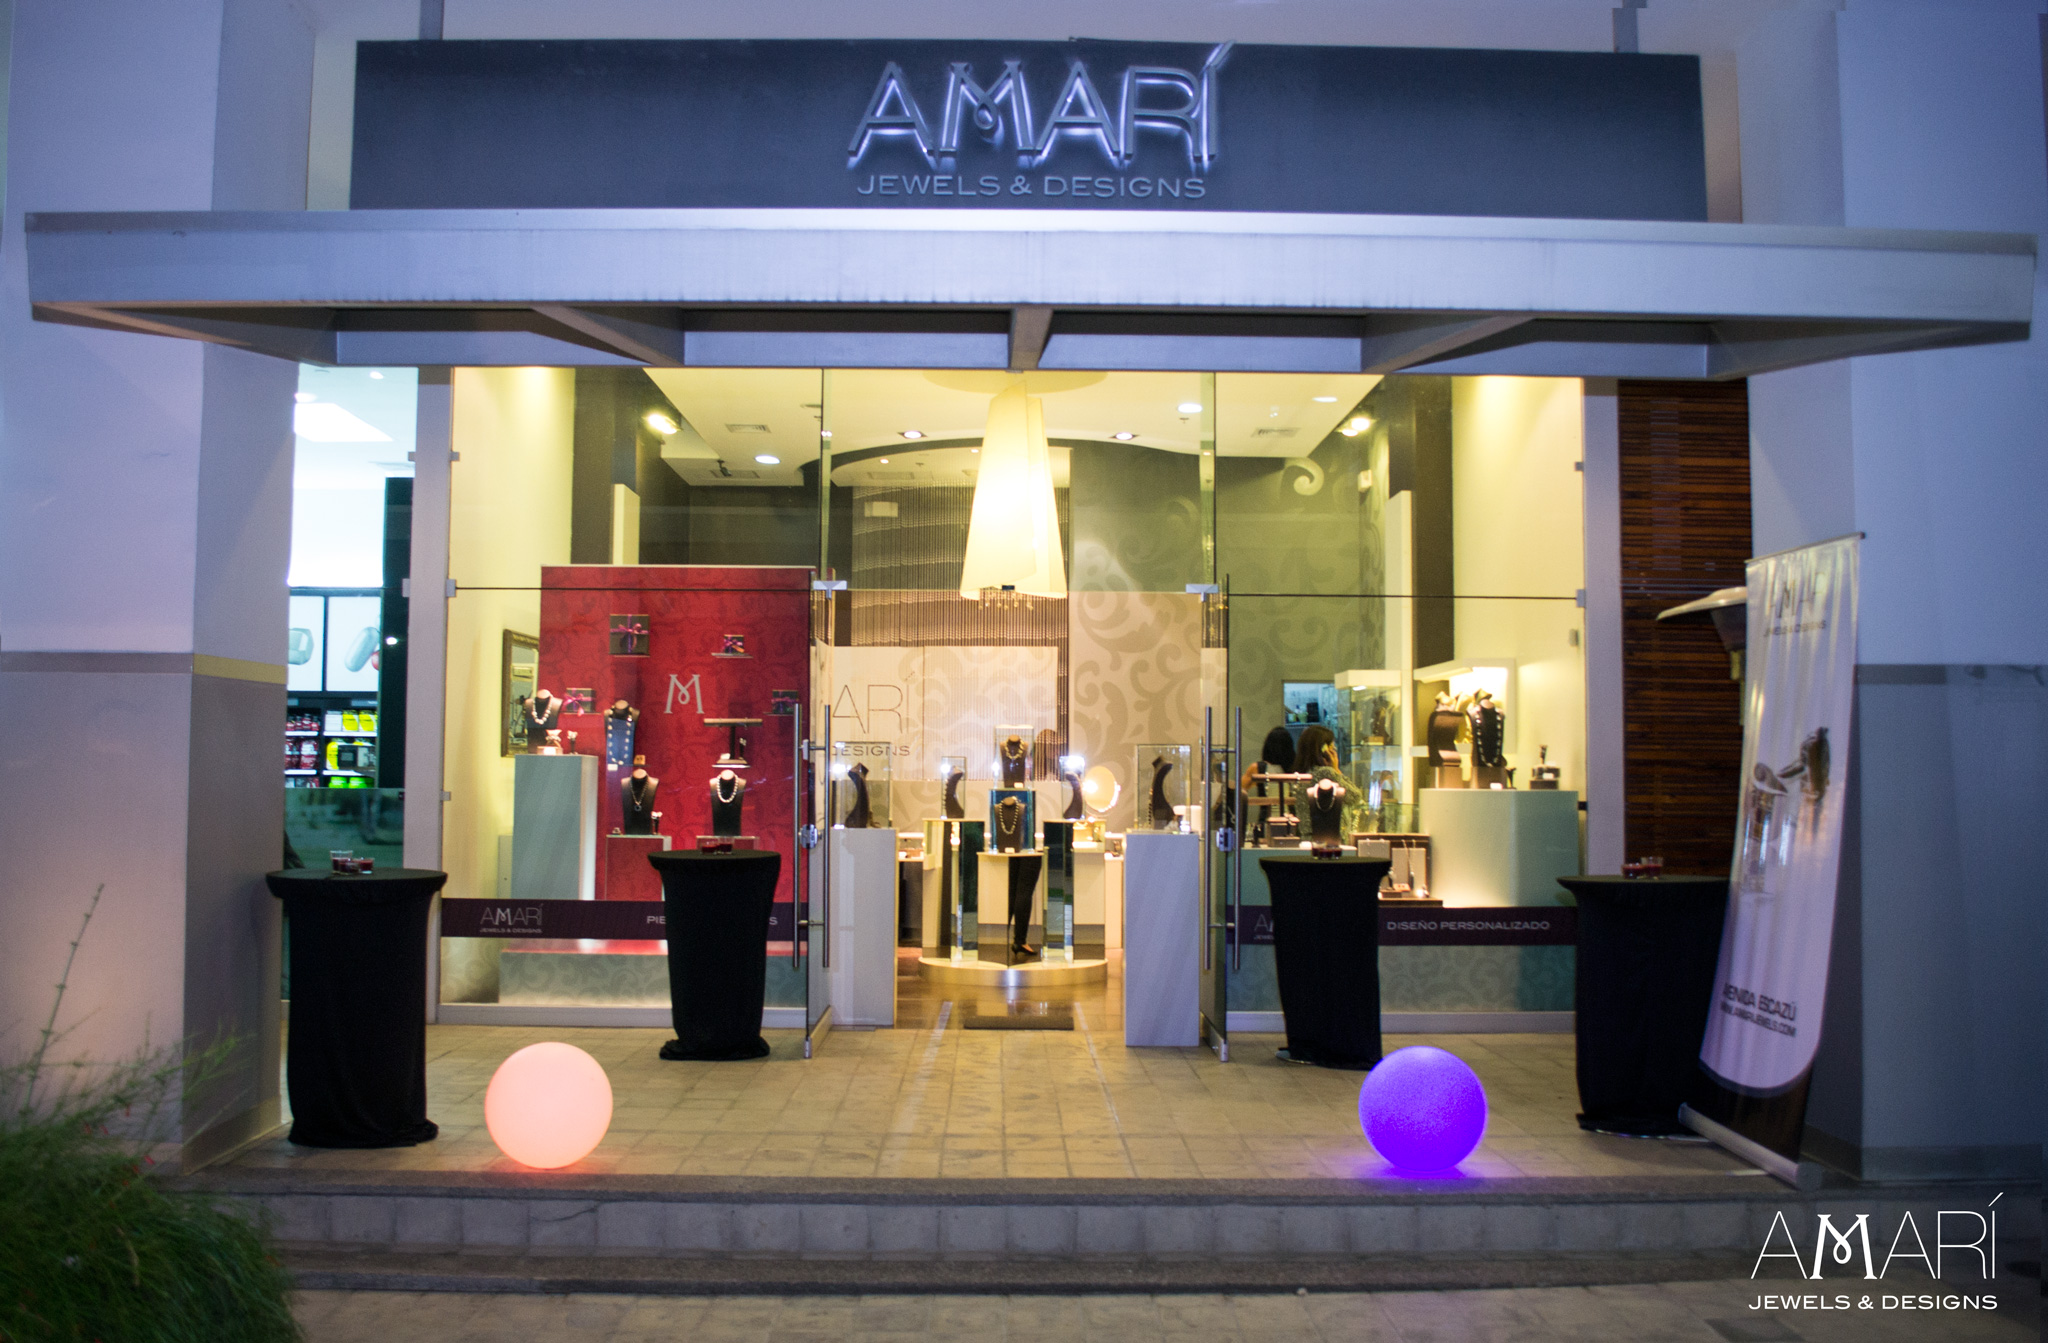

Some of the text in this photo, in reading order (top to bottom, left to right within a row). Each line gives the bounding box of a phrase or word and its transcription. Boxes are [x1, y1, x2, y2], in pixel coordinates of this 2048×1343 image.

[847, 40, 1234, 163] AMARÍ
[857, 175, 1206, 198] JEWELS & DESIGNS
[663, 673, 705, 714] M
[832, 671, 915, 734] ARÍ
[479, 903, 544, 926] AMARÍ
[1386, 920, 1550, 931] DISEÑO PERSONALIZADO
